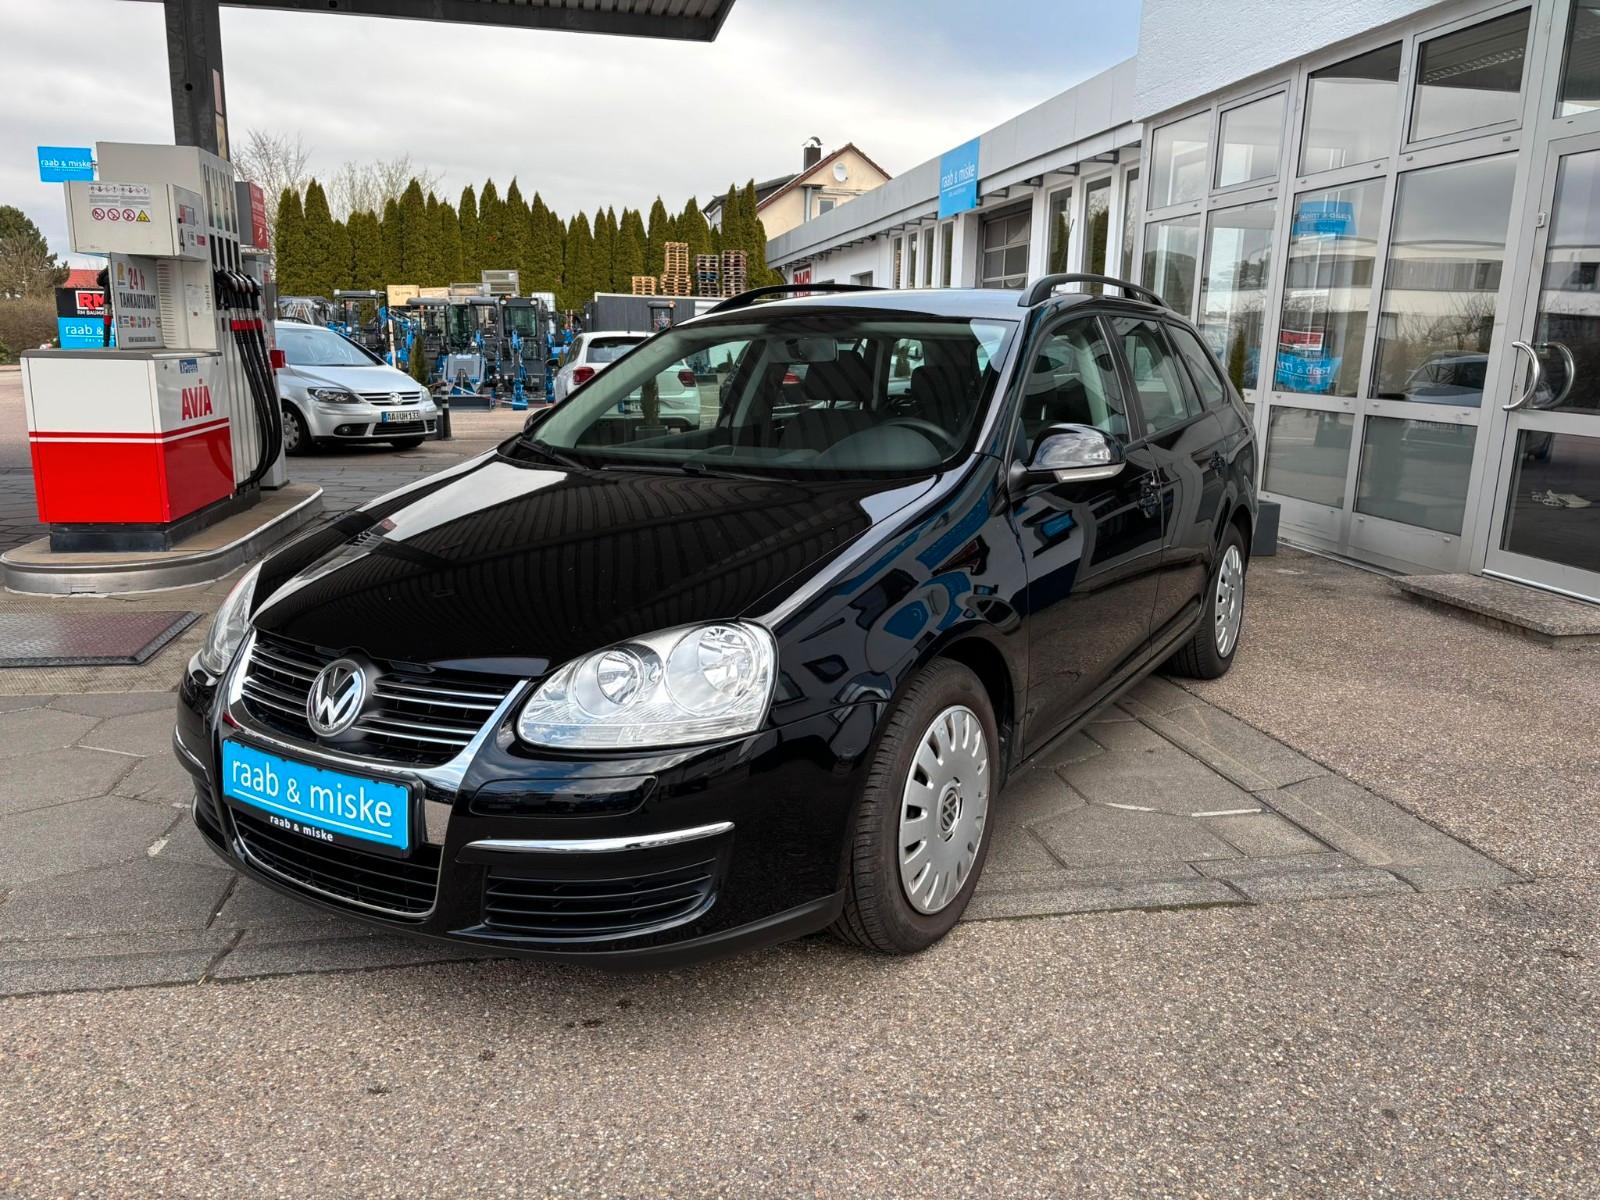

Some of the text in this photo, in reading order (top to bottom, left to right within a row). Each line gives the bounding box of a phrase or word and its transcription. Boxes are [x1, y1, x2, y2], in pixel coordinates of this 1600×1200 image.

[41, 158, 59, 166] raab
[128, 267, 138, 290] 24
[65, 325, 93, 335] raab
[182, 379, 213, 421] AVIA
[232, 759, 393, 827] raab & miske
[270, 815, 334, 842] raab & miske
